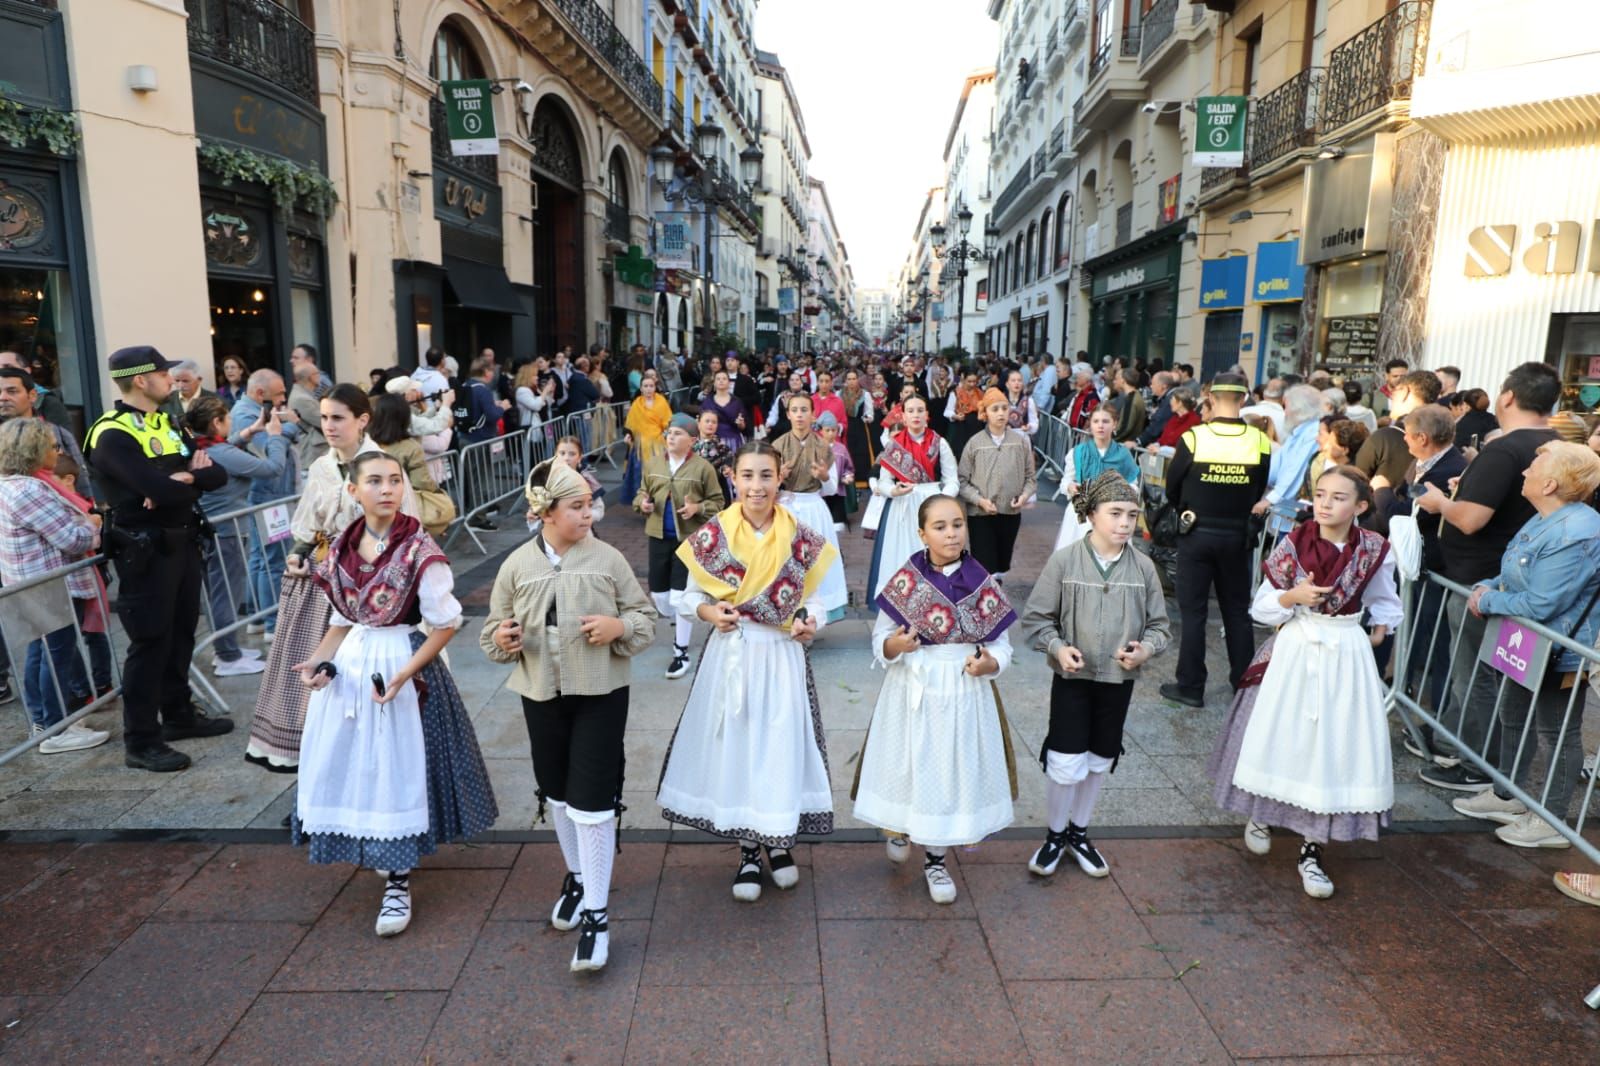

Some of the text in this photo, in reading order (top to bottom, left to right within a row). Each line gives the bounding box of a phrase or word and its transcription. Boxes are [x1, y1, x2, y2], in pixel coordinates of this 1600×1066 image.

[452, 87, 482, 98] SALIDA
[463, 100, 481, 111] EXIT
[1207, 103, 1237, 114] SALIDA
[469, 118, 476, 129] 3
[1214, 114, 1234, 125] EXIT
[1215, 132, 1222, 143] 3
[1321, 227, 1364, 249] santiago
[1464, 219, 1600, 277] sa
[1209, 464, 1246, 474] POLICIA
[1200, 473, 1250, 484] ZARAGOZA
[1496, 646, 1527, 672] ALCO
